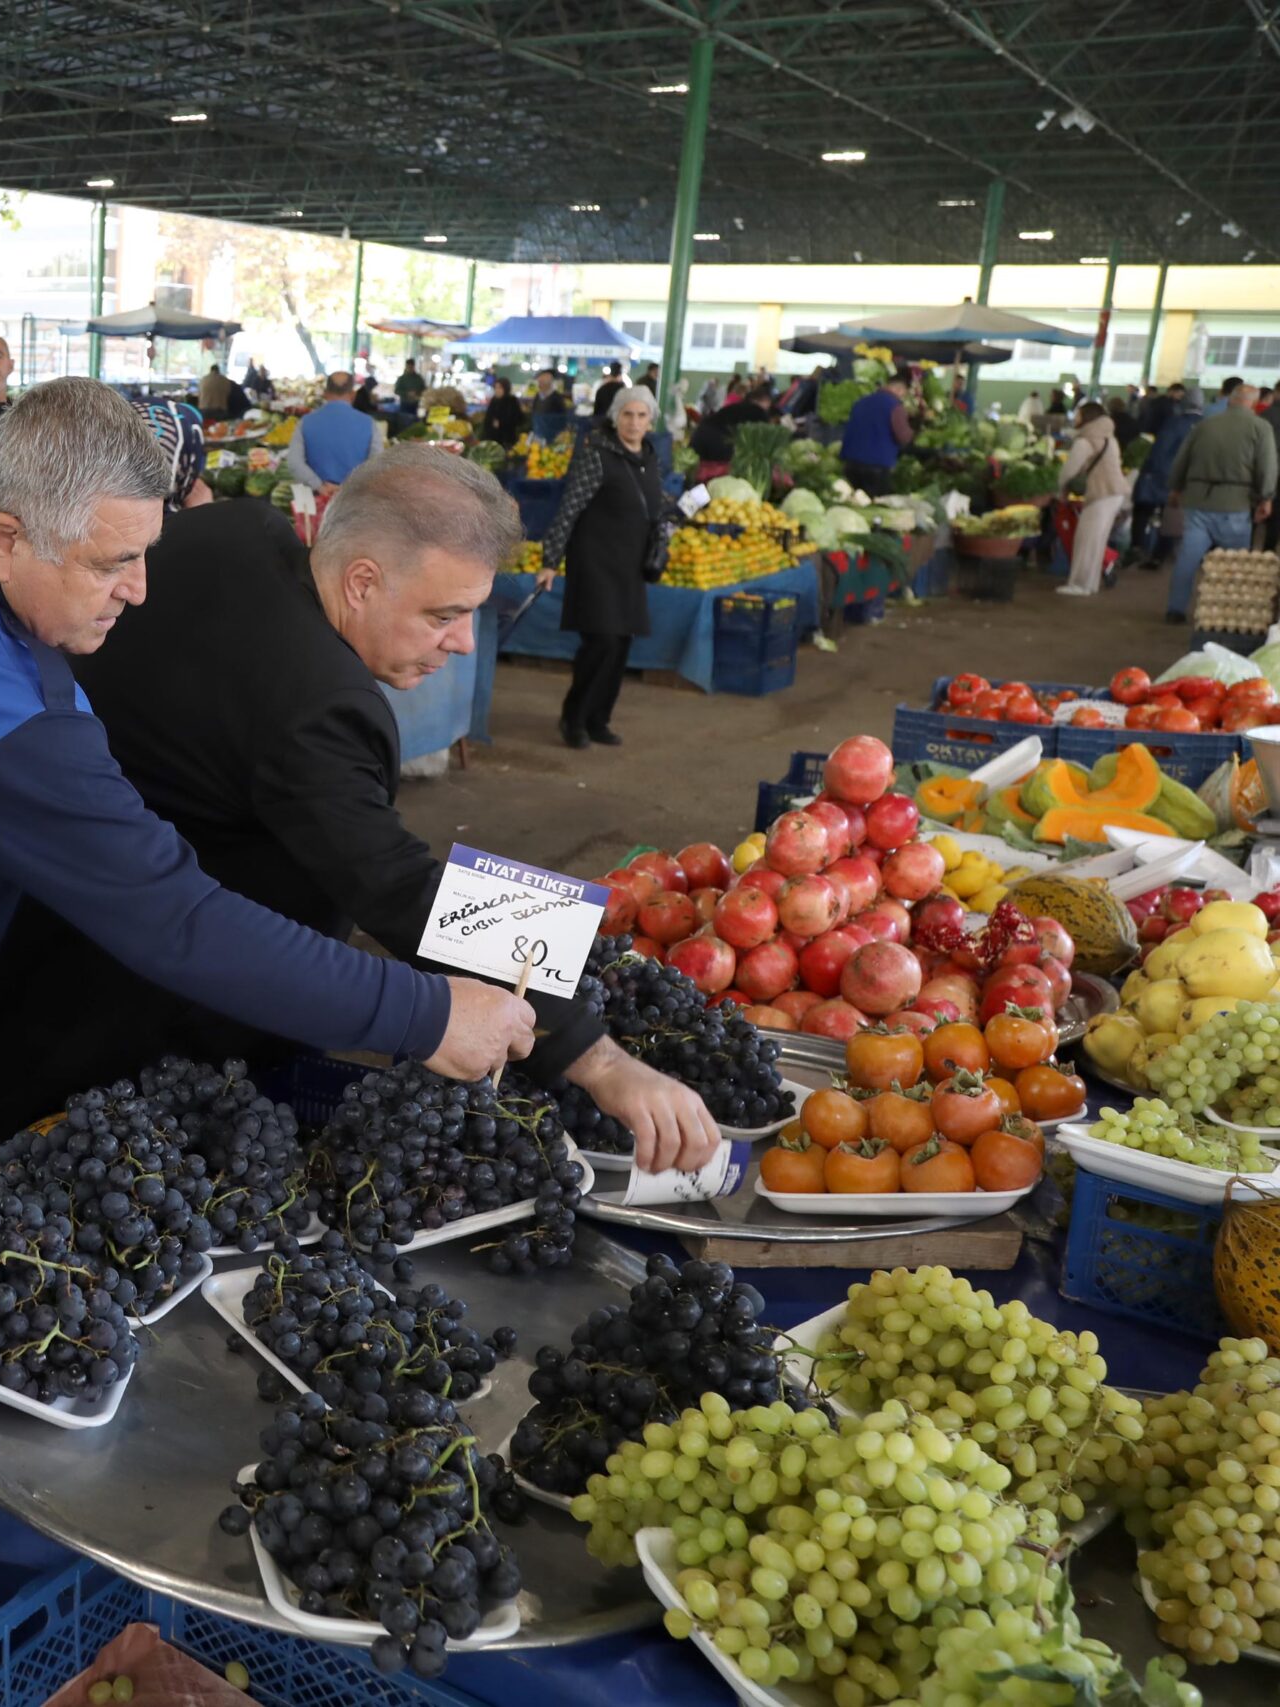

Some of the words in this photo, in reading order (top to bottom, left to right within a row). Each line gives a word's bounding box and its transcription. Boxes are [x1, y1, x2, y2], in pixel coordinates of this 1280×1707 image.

[474, 857, 520, 880] FİYAT
[521, 870, 585, 899] ETİKETİ
[511, 935, 549, 967] 80
[542, 967, 576, 983] TL
